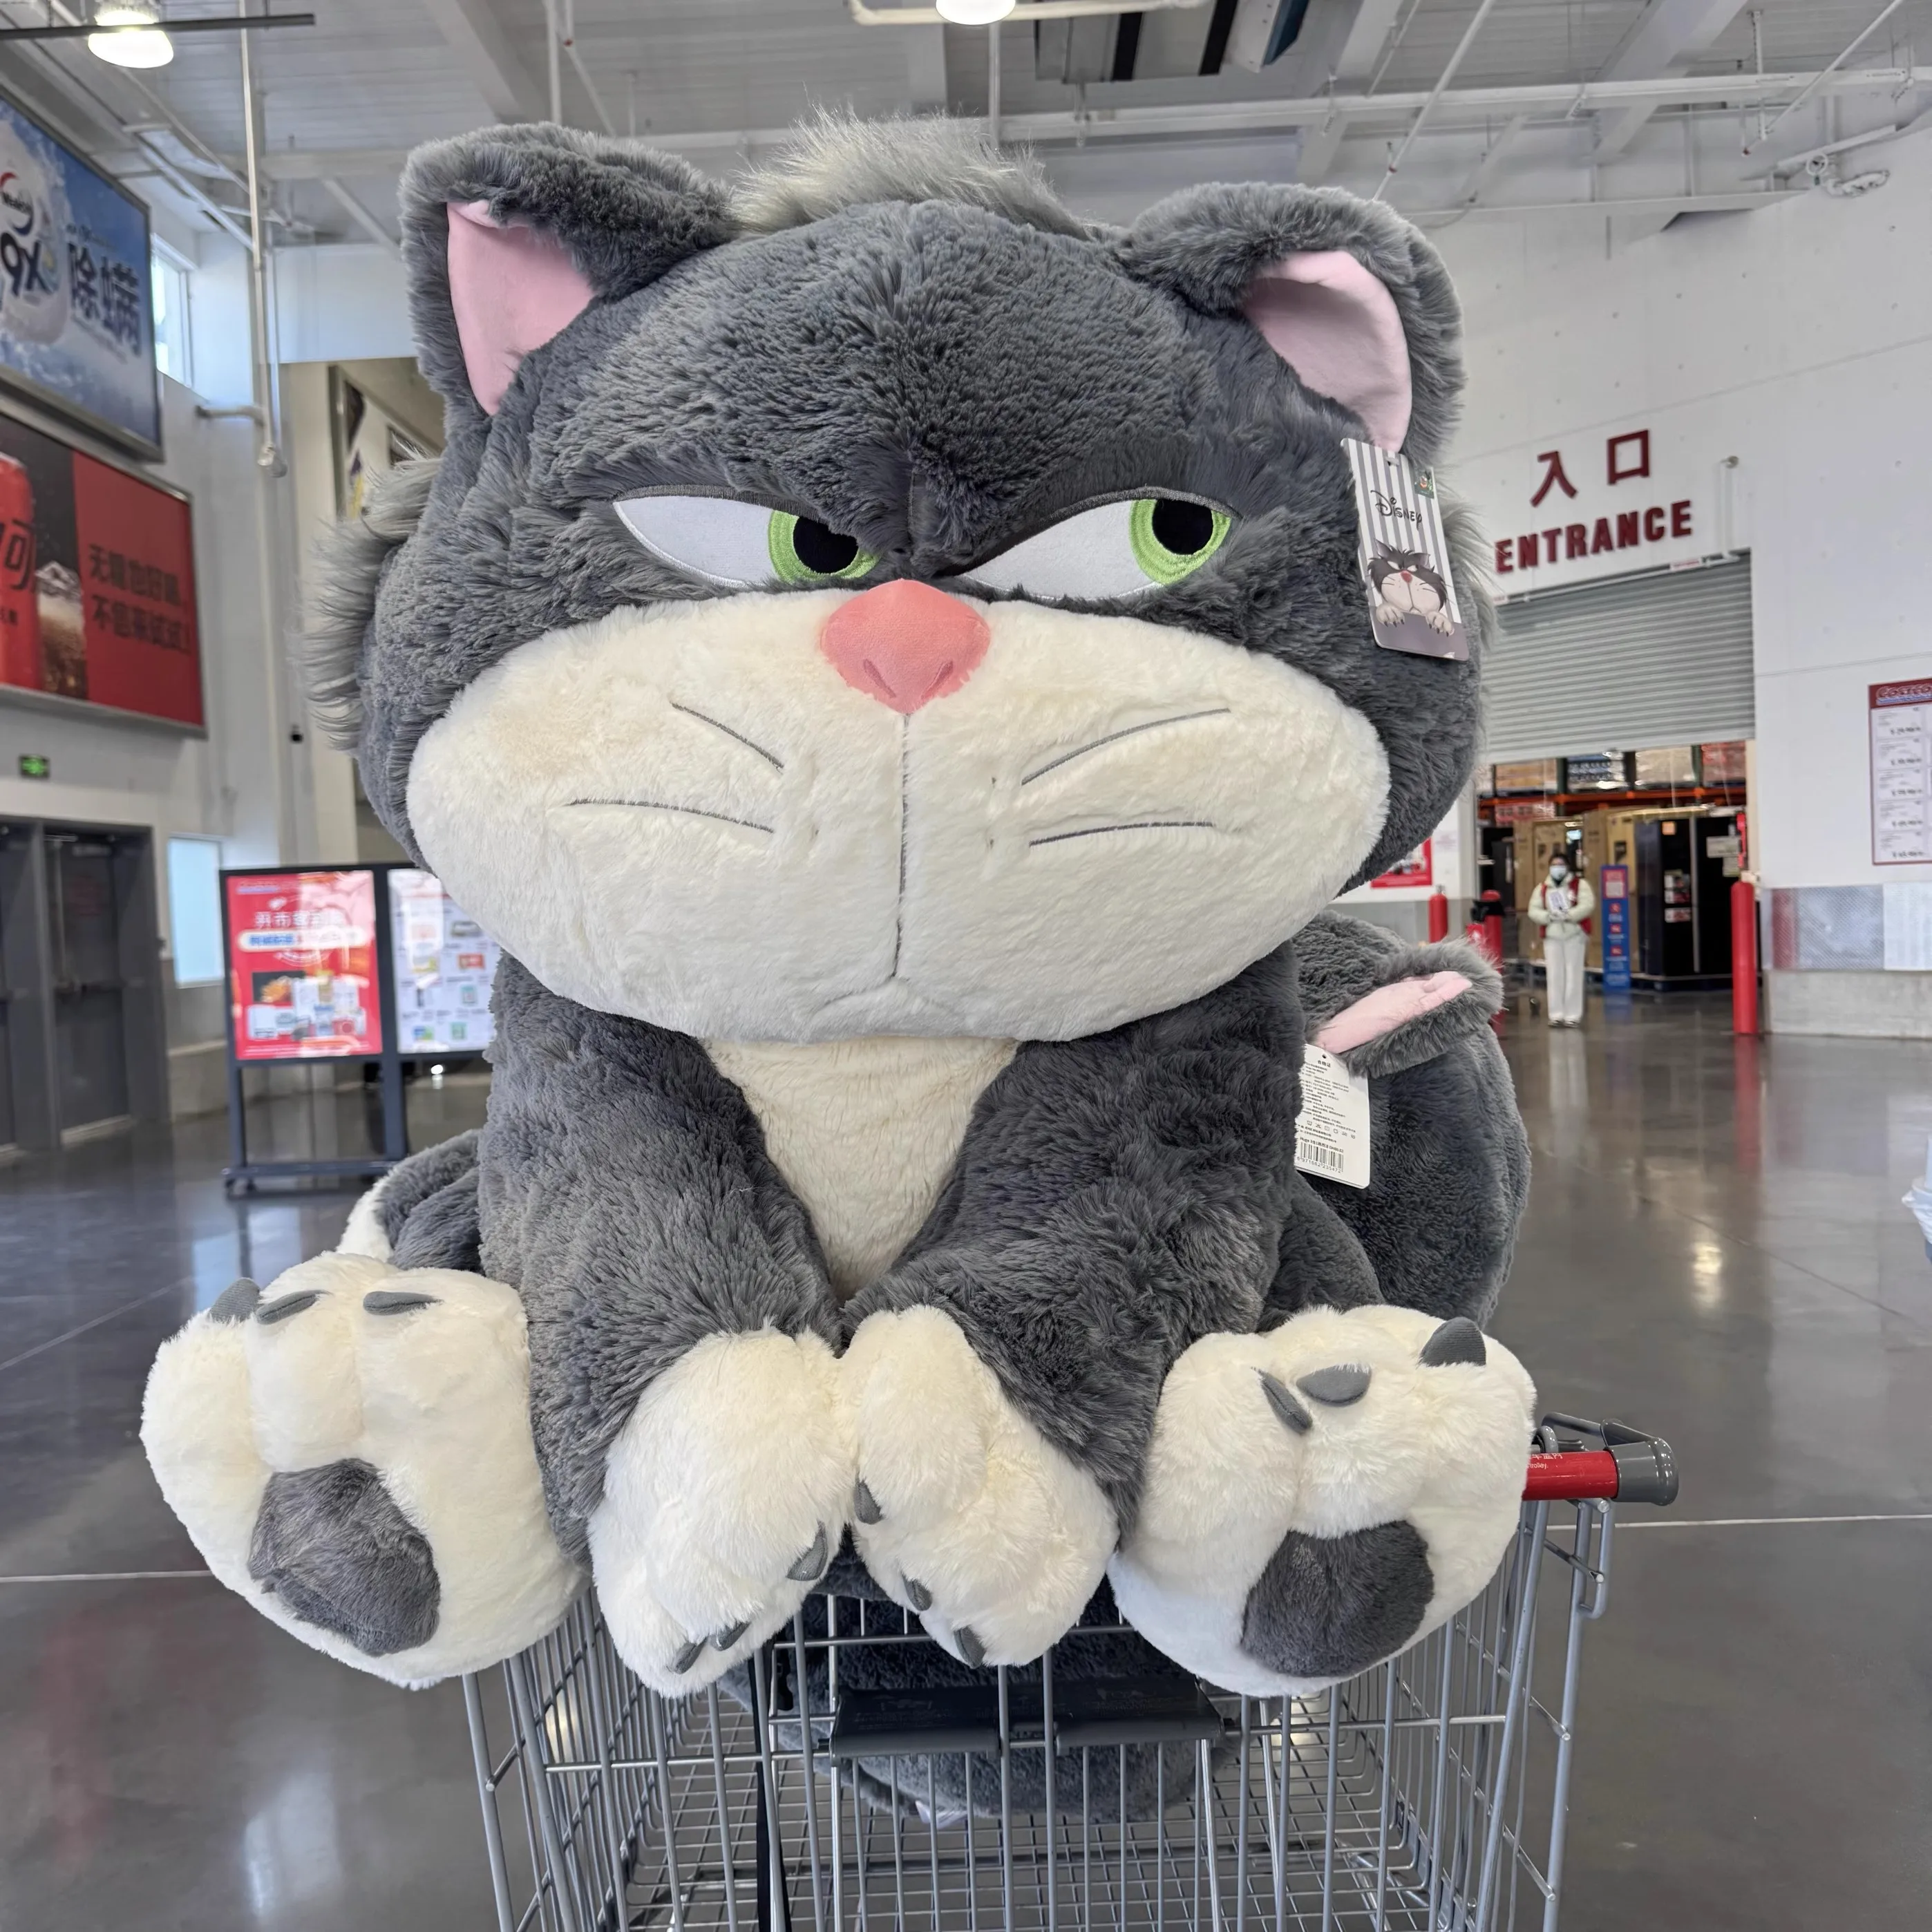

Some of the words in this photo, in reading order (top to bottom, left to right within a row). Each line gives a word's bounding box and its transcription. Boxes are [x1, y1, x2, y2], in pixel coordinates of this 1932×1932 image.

[1530, 428, 1650, 508] 入口
[1370, 490, 1422, 531] Disney
[1495, 500, 1692, 576] ENTRANCE
